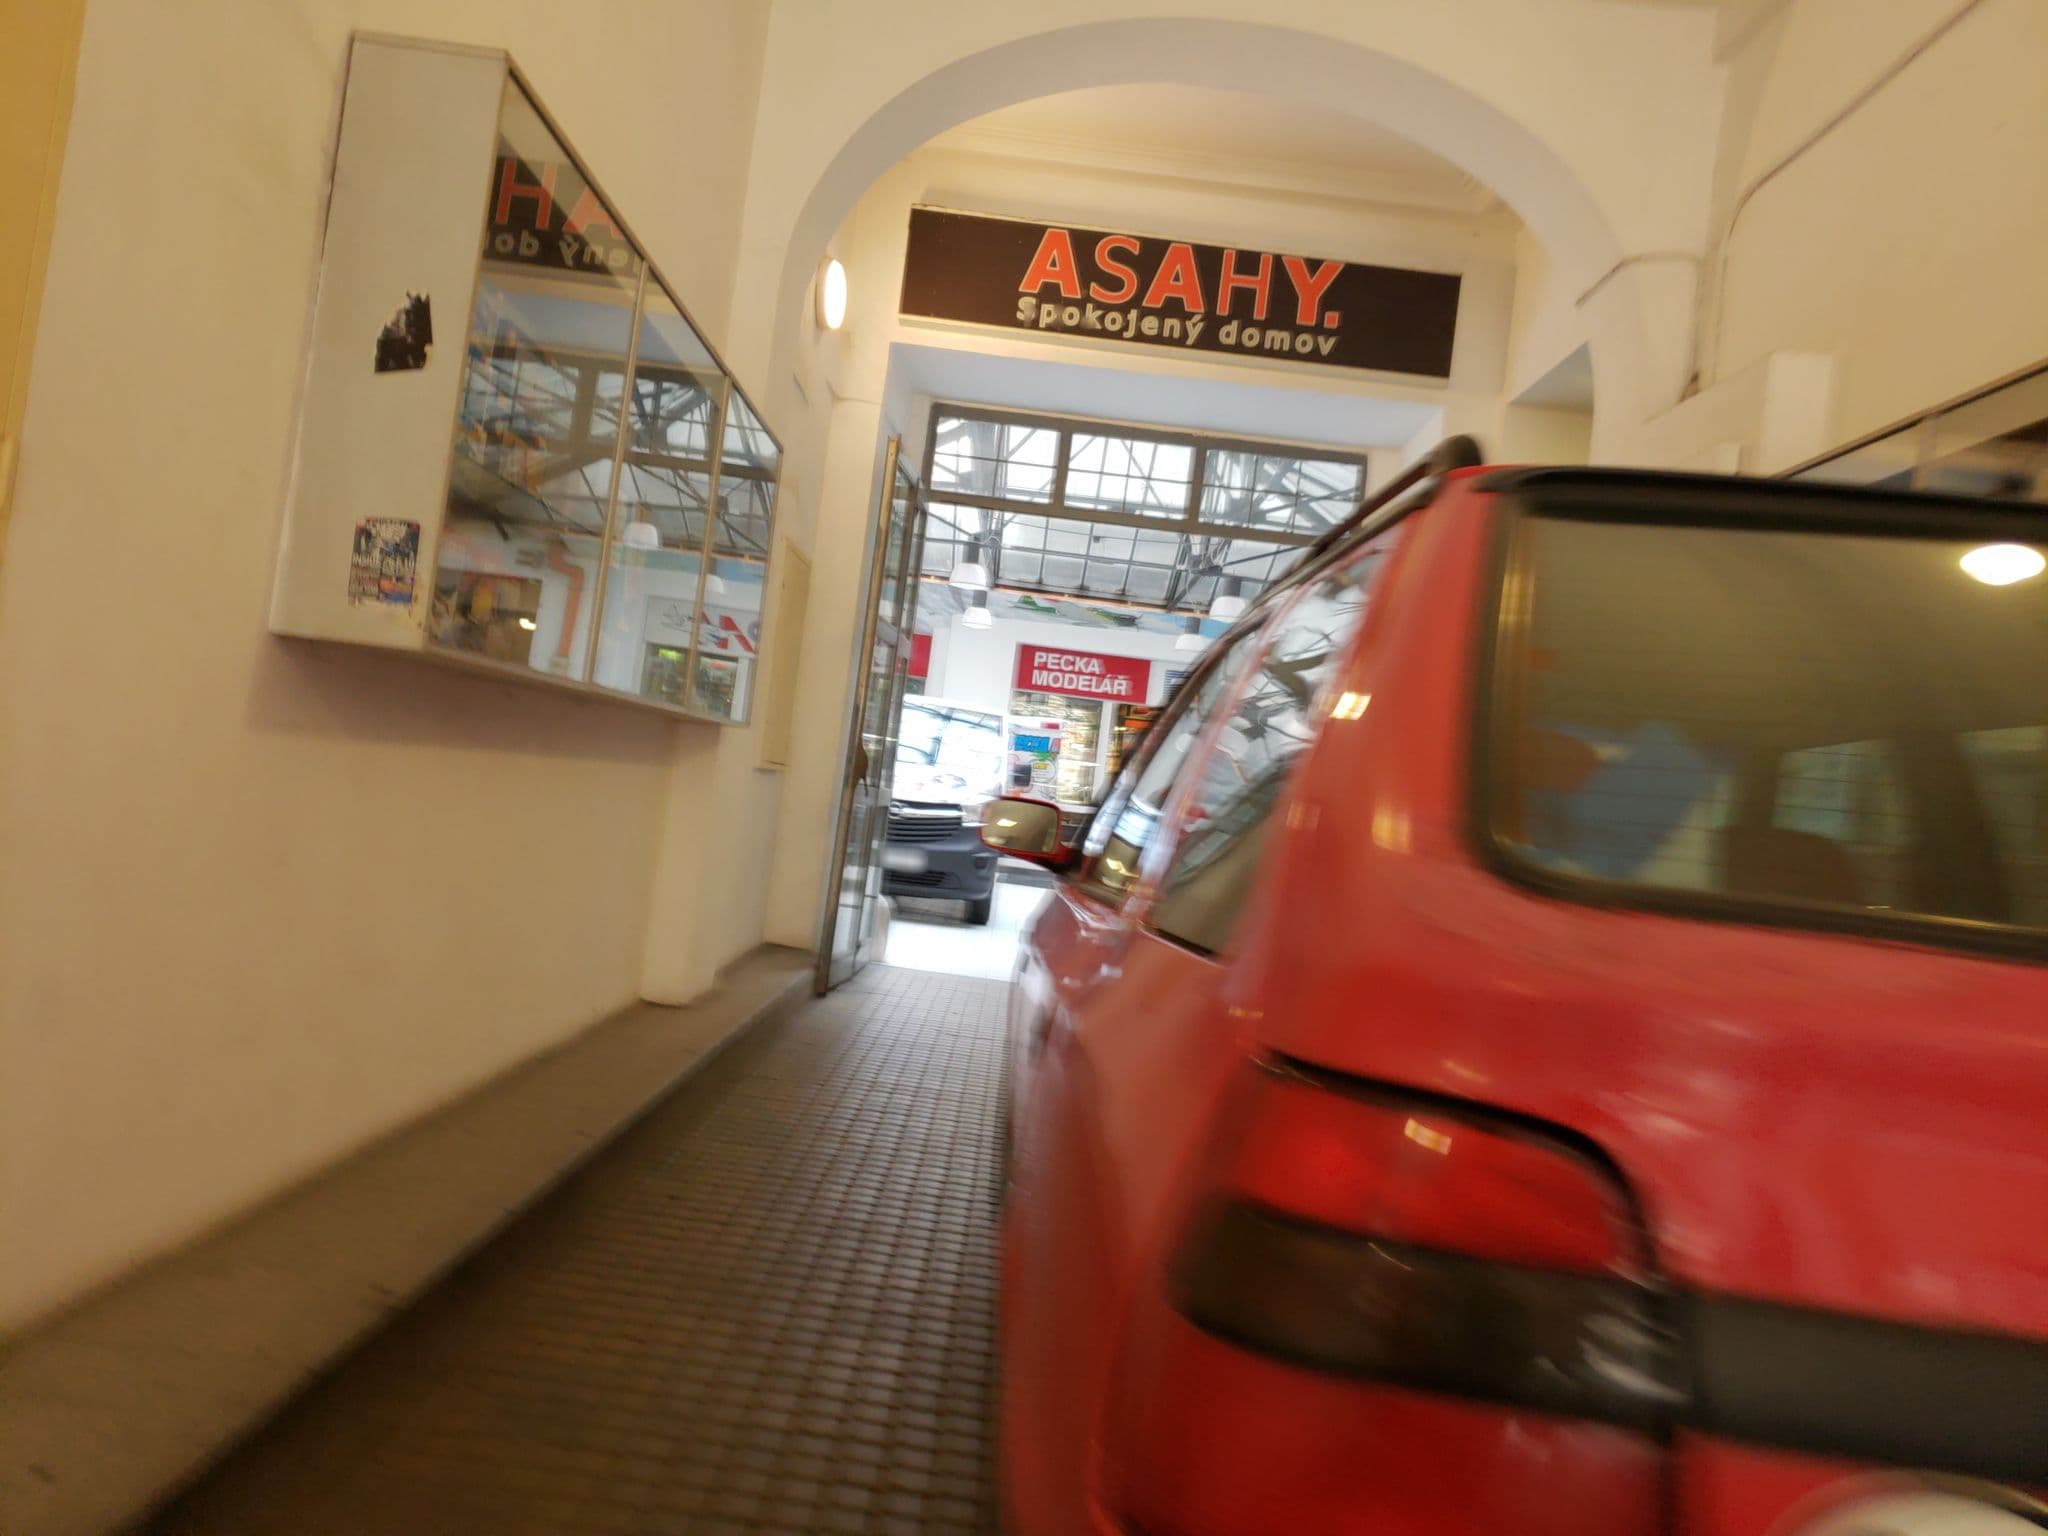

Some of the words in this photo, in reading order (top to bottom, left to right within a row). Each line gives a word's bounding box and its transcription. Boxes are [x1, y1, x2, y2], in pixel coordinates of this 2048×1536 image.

[1018, 228, 1345, 329] ASAHY.
[1016, 296, 1205, 345] Spokojený
[1218, 319, 1338, 356] domov
[1031, 669, 1131, 697] MODELÁŘ
[1033, 651, 1103, 675] PECKA
